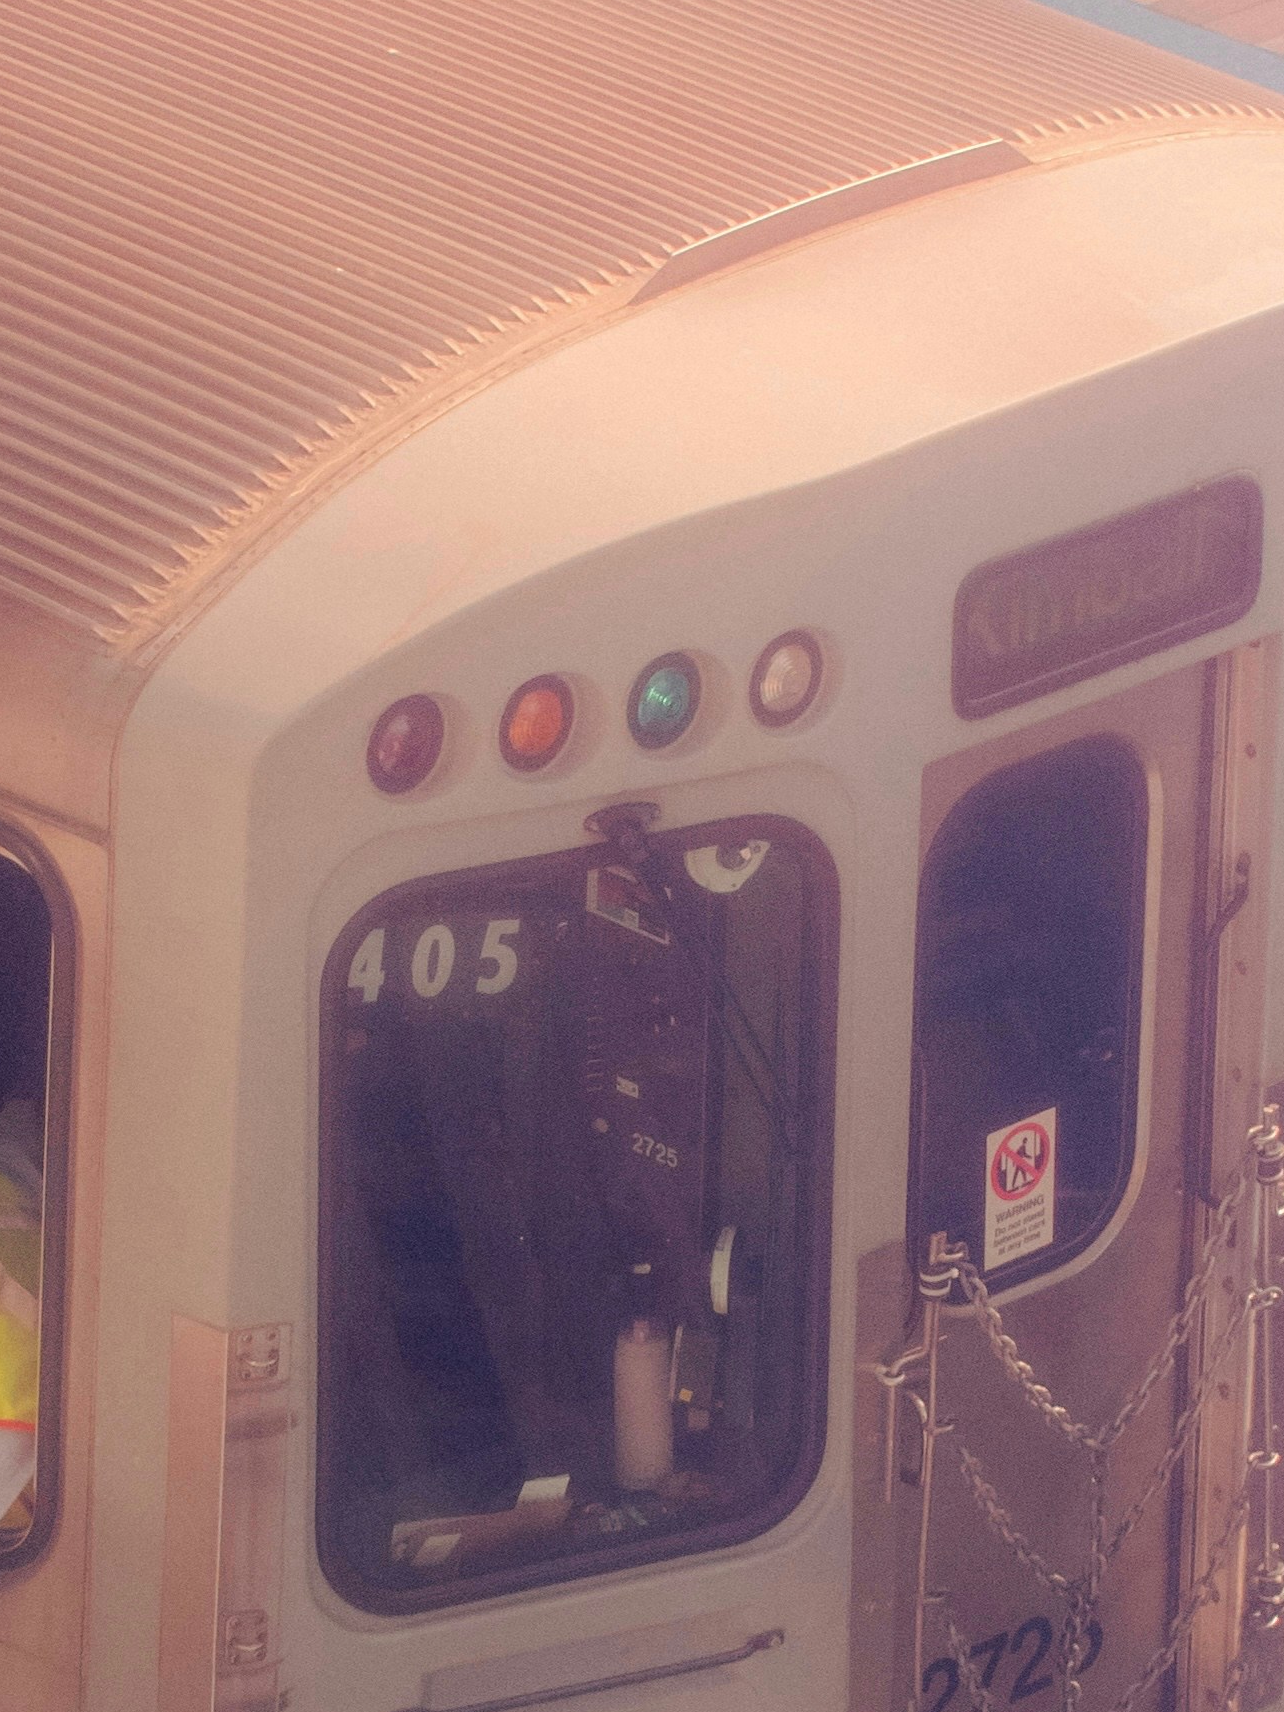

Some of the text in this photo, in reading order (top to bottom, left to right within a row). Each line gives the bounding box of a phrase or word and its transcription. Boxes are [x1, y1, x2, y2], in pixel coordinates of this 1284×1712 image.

[347, 918, 522, 1003] 405
[632, 1133, 678, 1167] 2725
[994, 1194, 1045, 1225] WARNING
